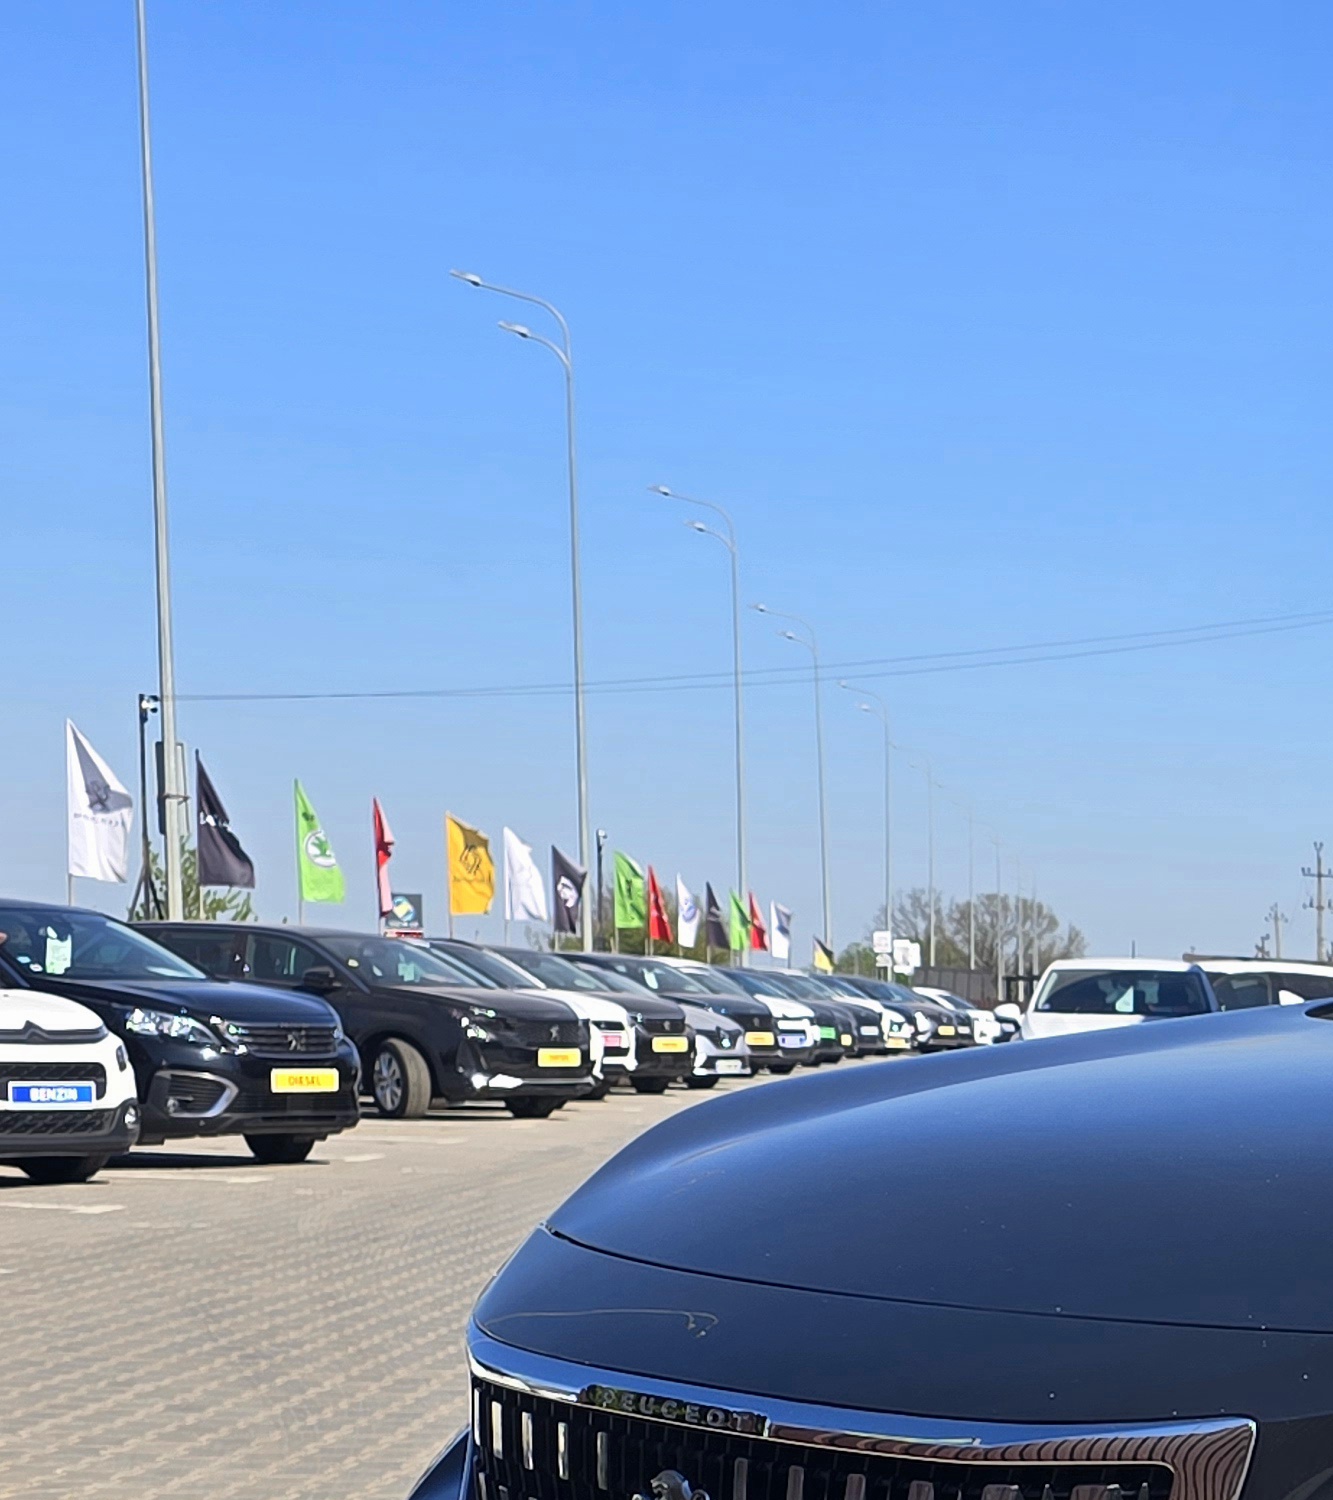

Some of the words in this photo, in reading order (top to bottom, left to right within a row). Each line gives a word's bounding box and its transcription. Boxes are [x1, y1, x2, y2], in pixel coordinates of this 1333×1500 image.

[288, 1075, 322, 1087] DIESEL
[29, 1086, 79, 1102] BENZIN
[602, 1388, 750, 1431] PEUGEOT
